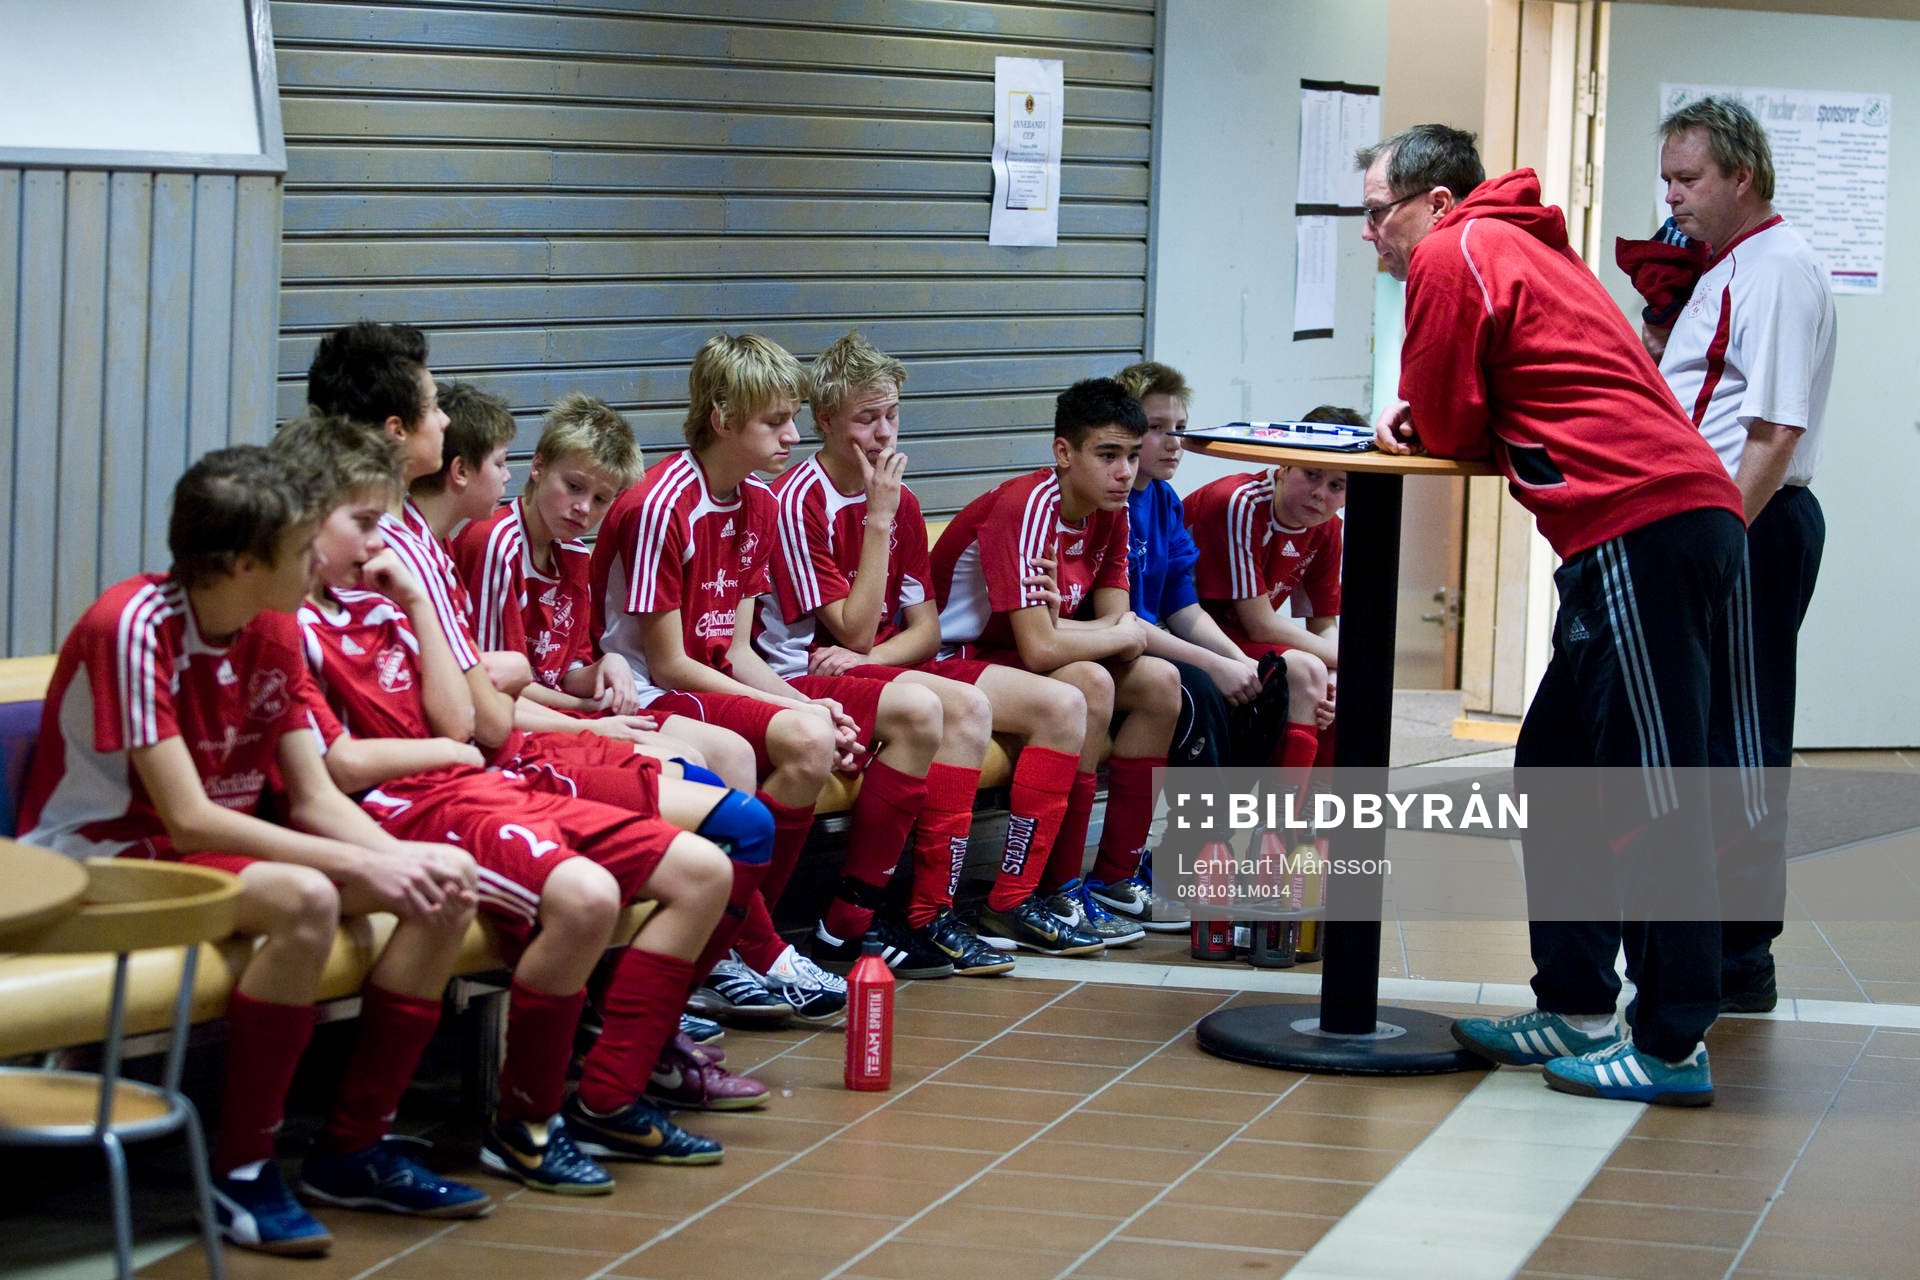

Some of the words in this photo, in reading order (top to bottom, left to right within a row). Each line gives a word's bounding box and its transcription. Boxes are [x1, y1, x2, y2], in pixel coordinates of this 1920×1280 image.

[1001, 814, 1035, 875] STADIUM
[869, 992, 882, 1029] SPORTIA
[867, 1033, 880, 1073] TEAM
